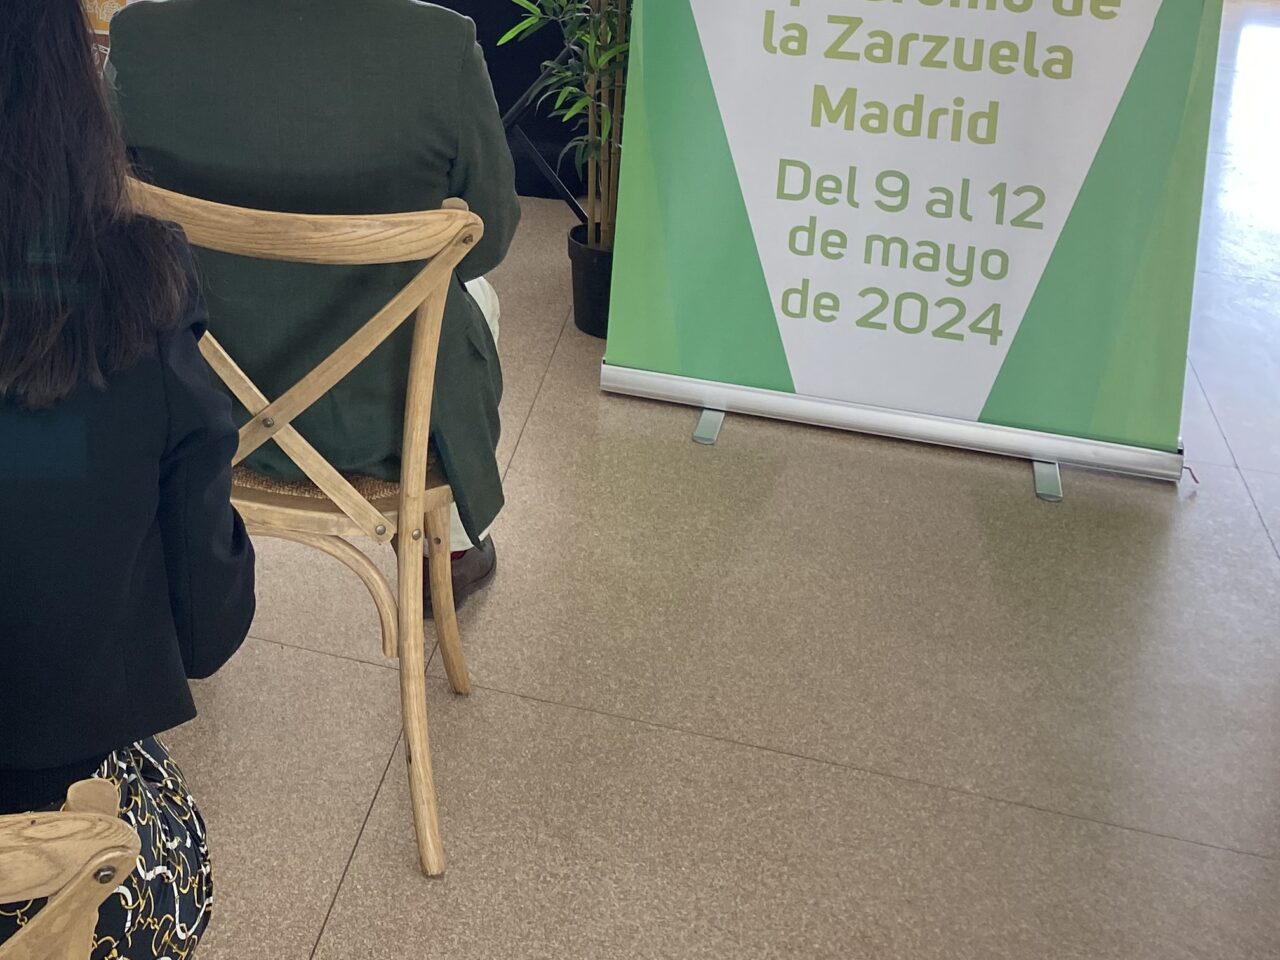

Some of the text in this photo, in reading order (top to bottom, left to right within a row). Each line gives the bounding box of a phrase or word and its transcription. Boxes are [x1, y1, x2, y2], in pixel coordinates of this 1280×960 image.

[762, 10, 1073, 80] la Zarzuela
[810, 84, 1000, 145] Madrid
[776, 158, 1046, 230] Del 9 al 12
[788, 216, 1010, 287] de mayo
[781, 279, 1003, 346] de 2024
